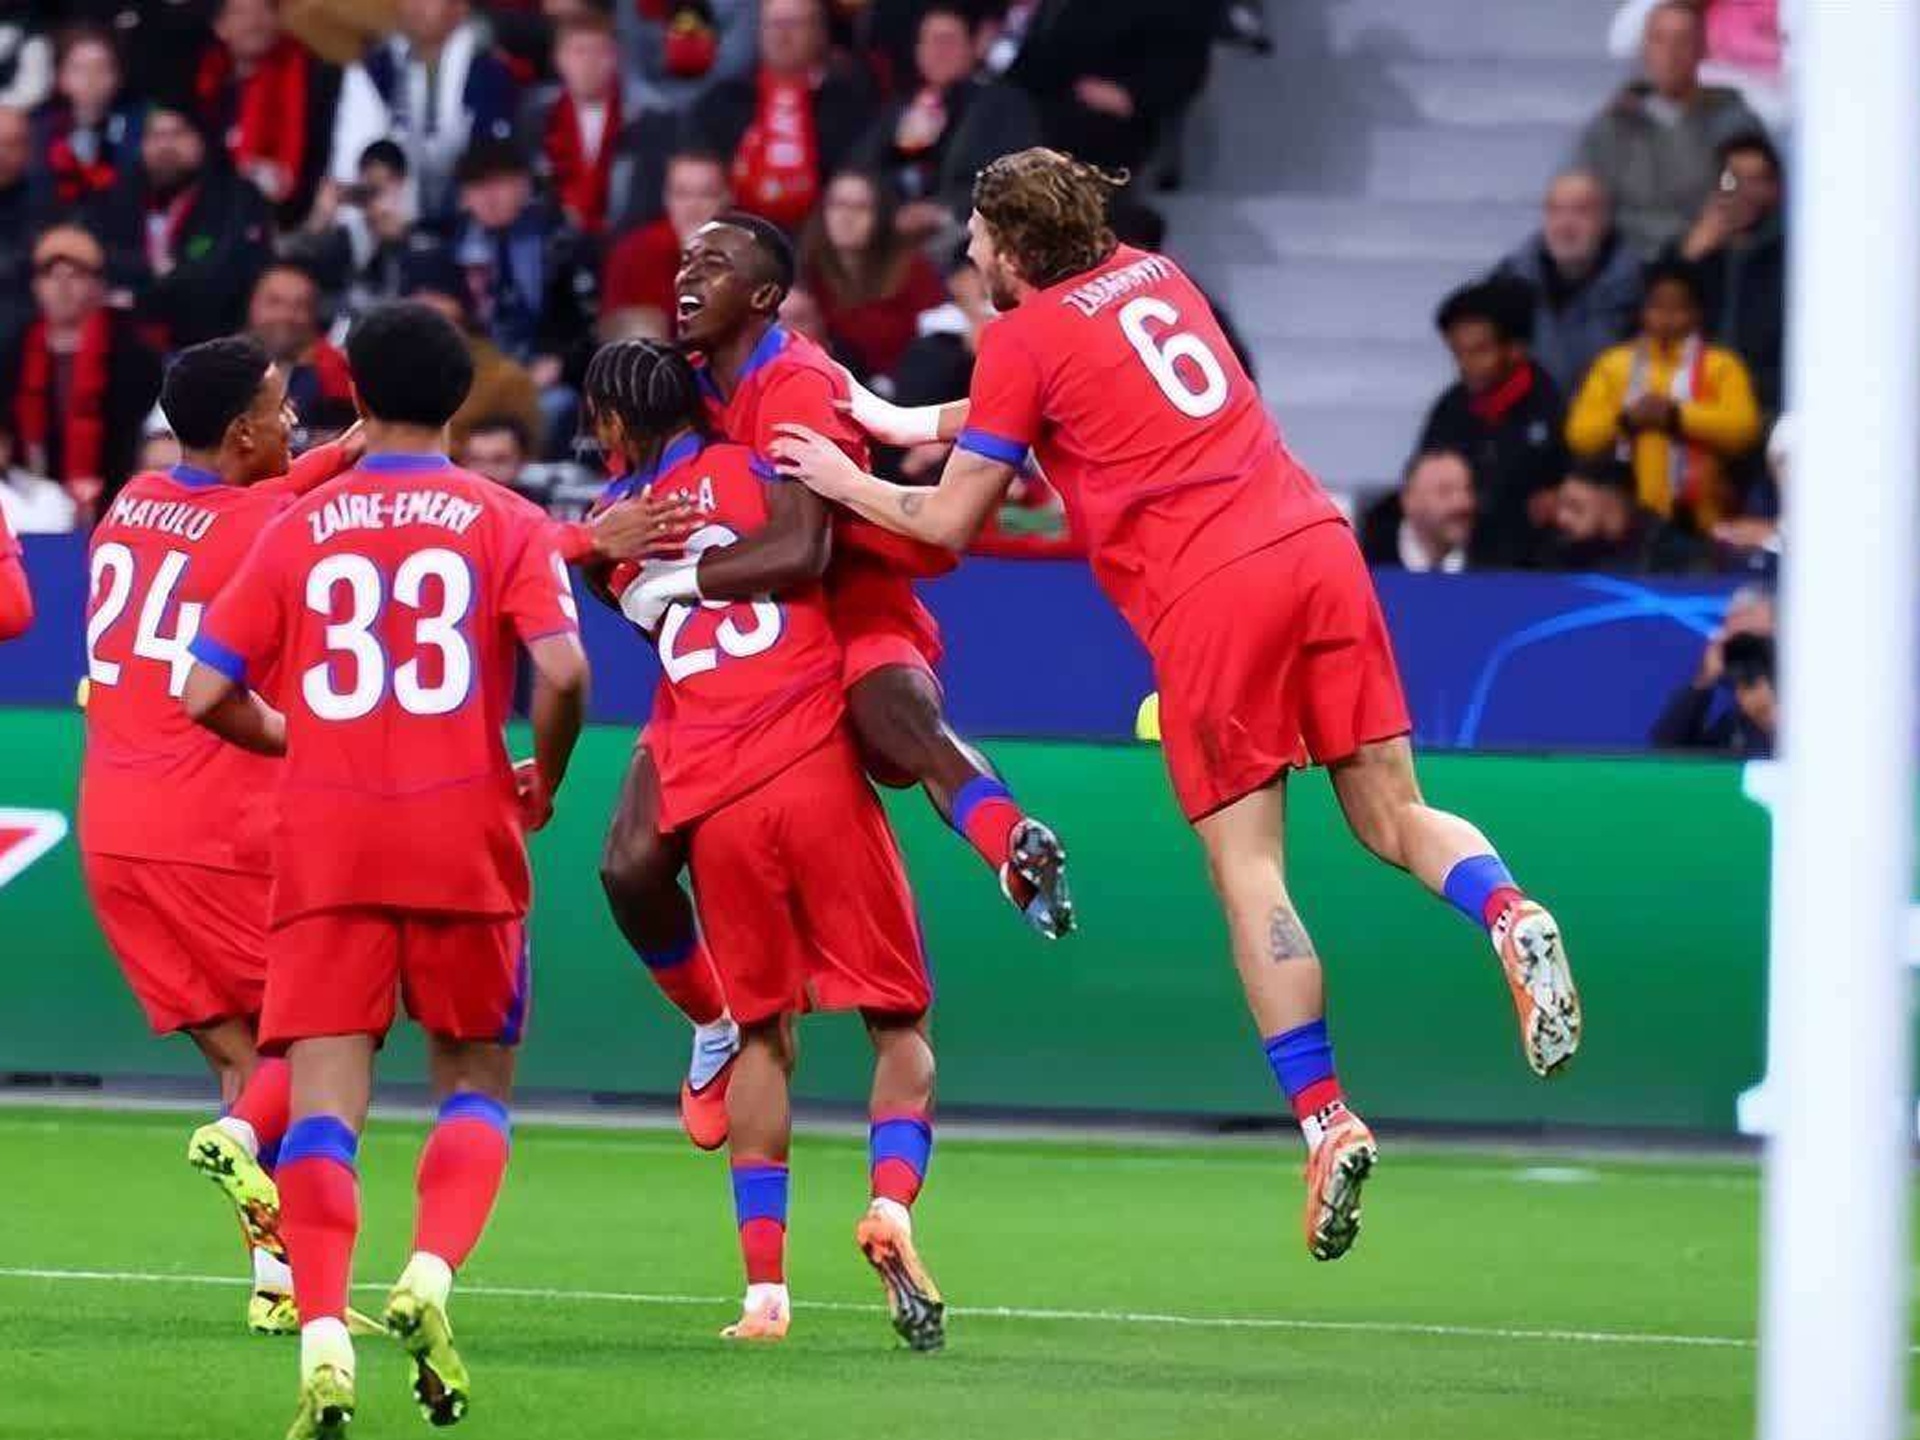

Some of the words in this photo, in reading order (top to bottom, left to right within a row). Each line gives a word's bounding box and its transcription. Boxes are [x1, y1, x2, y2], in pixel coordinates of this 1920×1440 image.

[1119, 297, 1228, 417] 6
[108, 498, 218, 541] MAYULU
[87, 542, 203, 697] 24
[303, 548, 471, 720] 33
